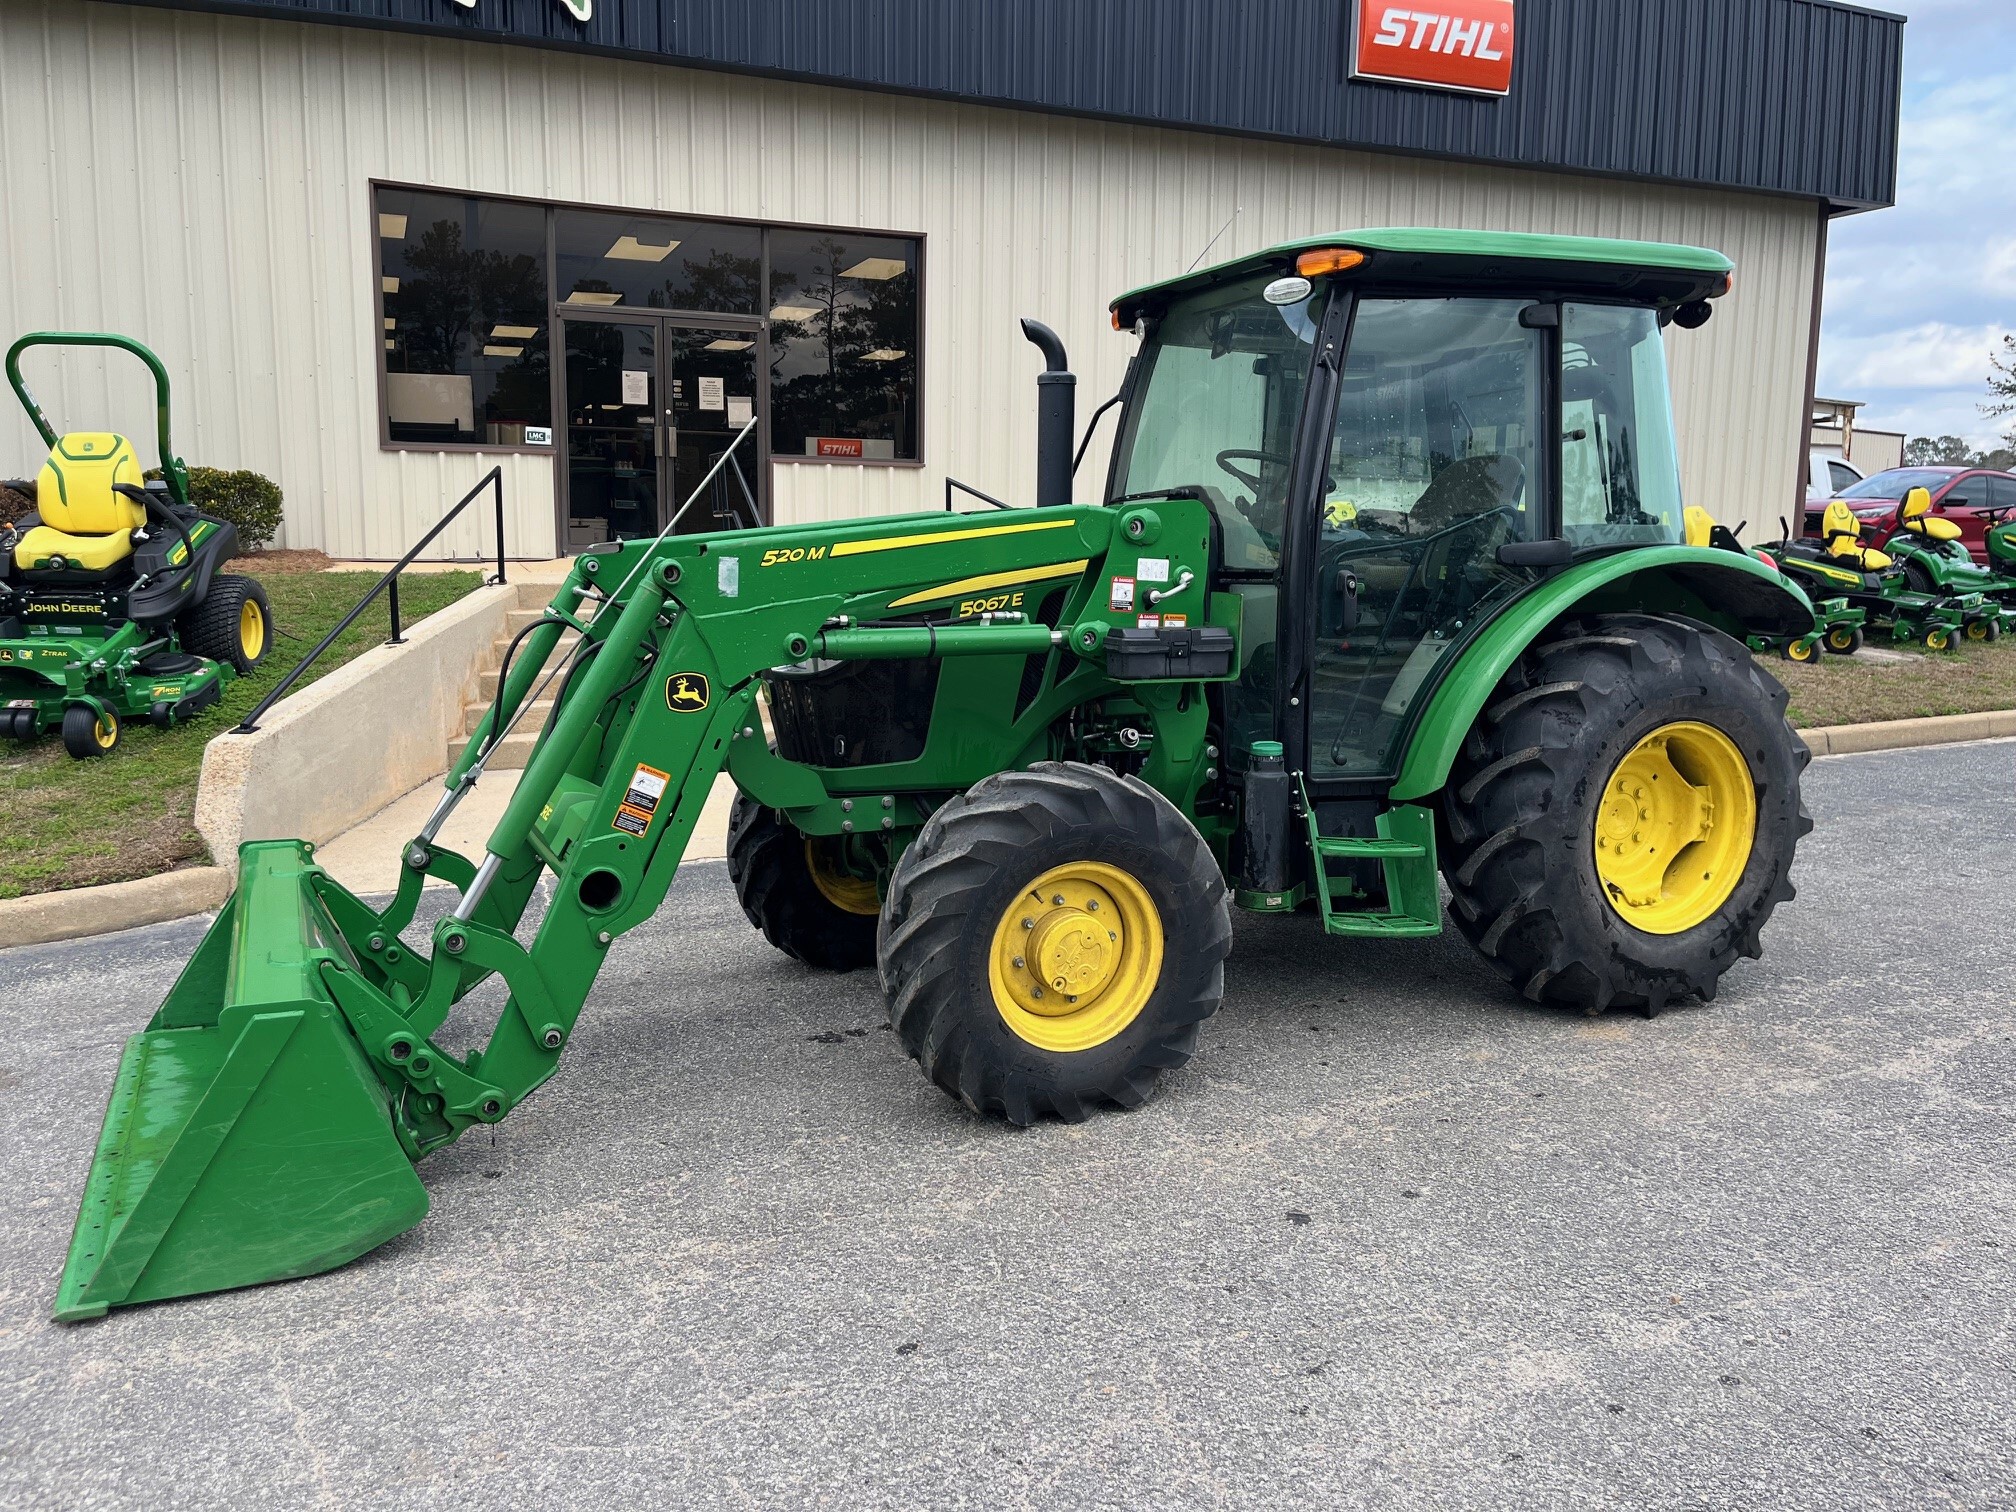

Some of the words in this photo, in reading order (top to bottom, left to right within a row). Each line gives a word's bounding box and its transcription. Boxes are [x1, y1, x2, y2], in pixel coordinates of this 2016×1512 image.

[1373, 8, 1502, 61] STIHL
[822, 444, 858, 455] STIHL
[760, 547, 805, 567] 520
[806, 546, 827, 561] M
[27, 603, 60, 613] JOHN
[61, 603, 102, 613] DEERE
[960, 594, 1010, 618] 5067
[1011, 592, 1024, 607] E
[41, 649, 68, 657] ZTRAK
